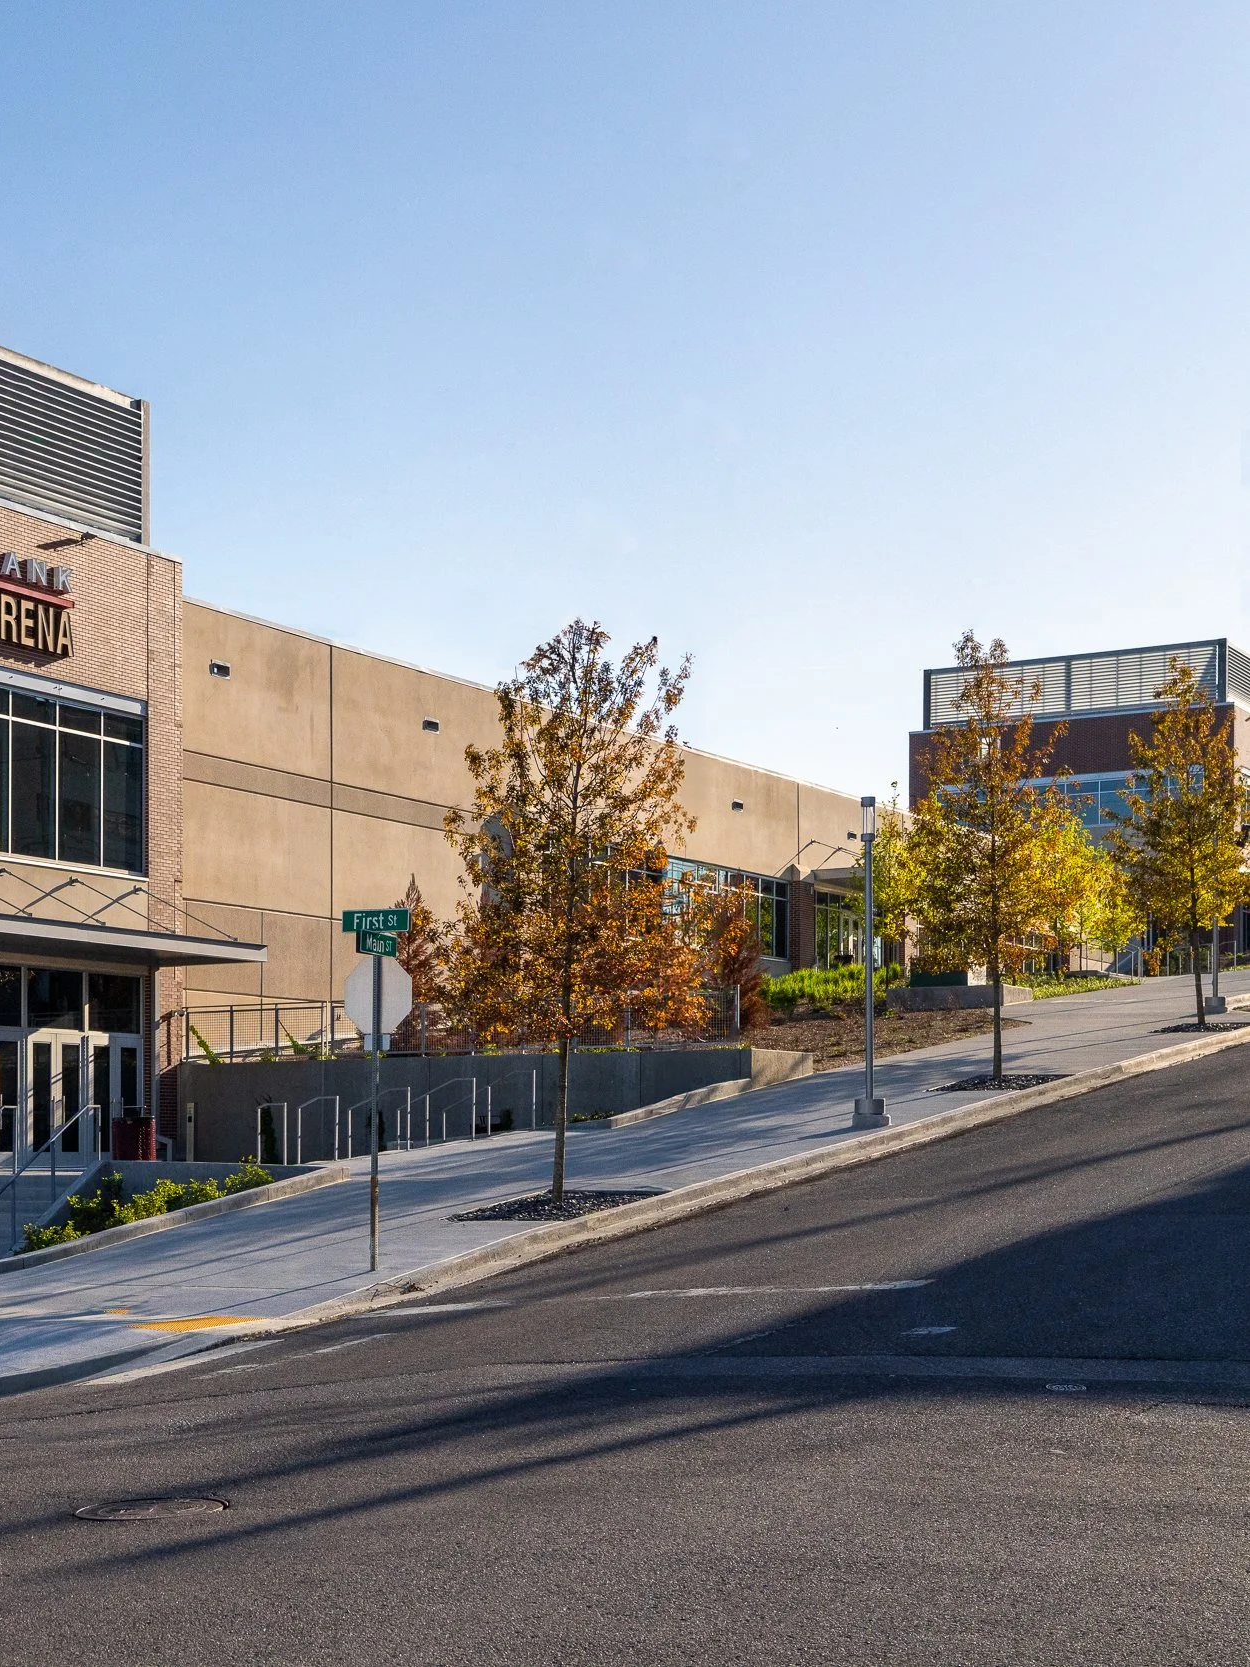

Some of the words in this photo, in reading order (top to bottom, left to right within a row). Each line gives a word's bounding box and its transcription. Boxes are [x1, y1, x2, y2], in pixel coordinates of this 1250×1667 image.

[353, 913, 384, 930] First
[387, 914, 398, 926] St
[366, 934, 384, 953] Main
